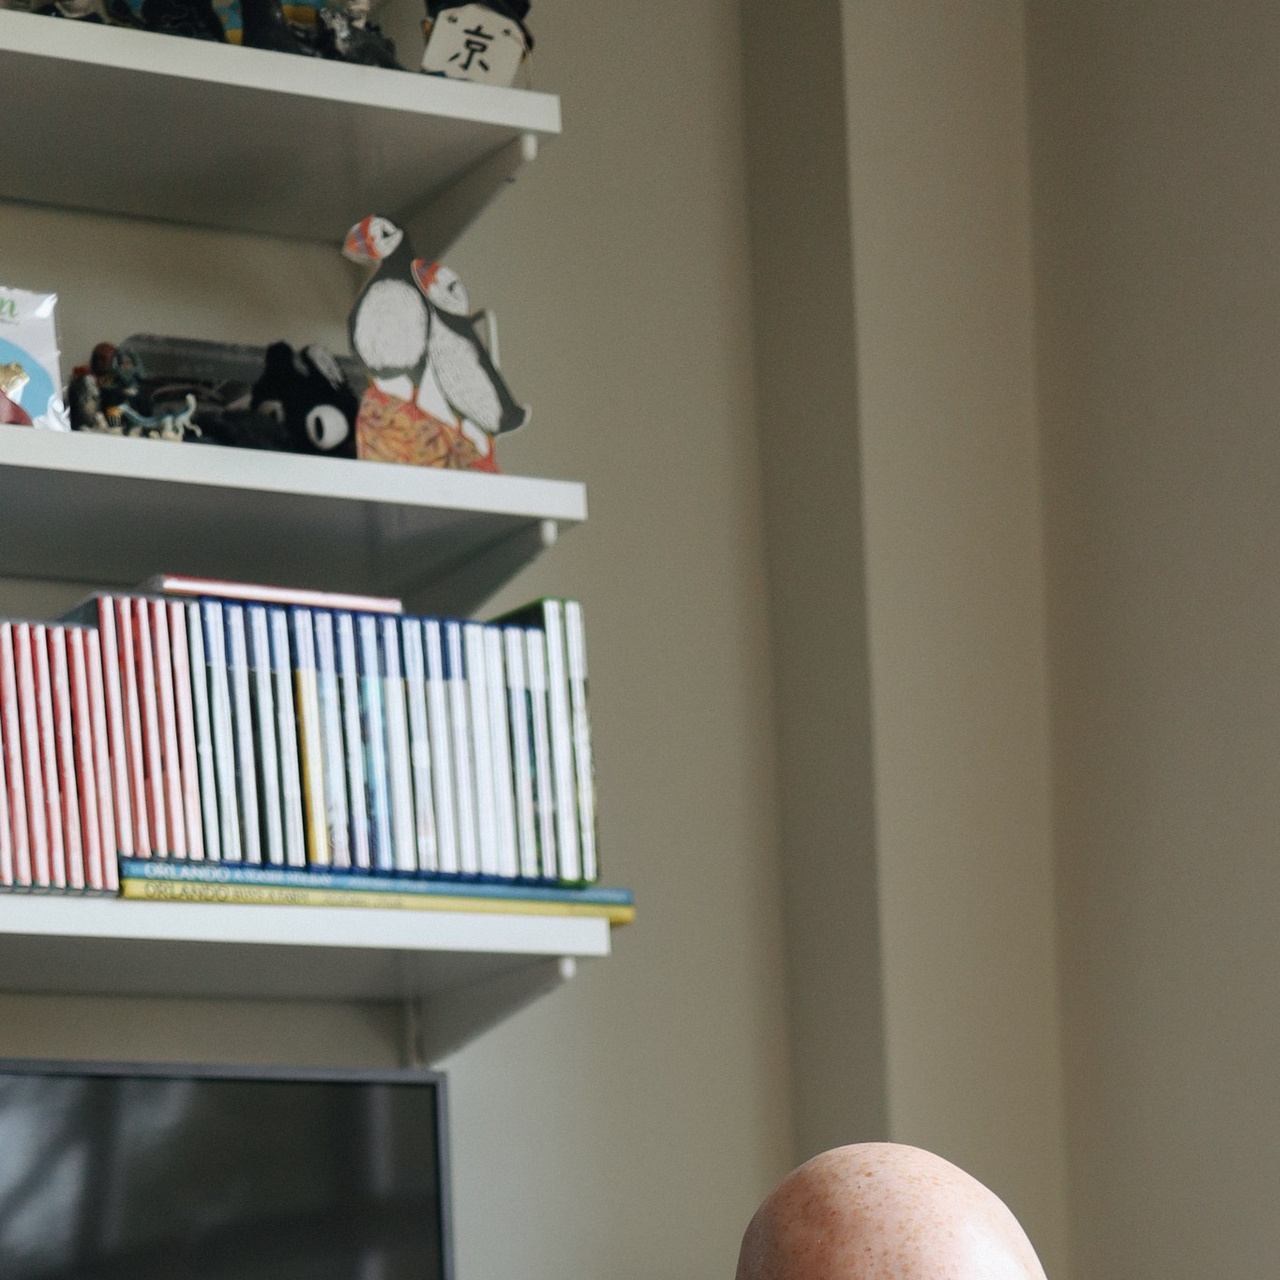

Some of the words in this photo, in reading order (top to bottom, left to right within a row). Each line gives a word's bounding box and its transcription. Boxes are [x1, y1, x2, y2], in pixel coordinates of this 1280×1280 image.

[448, 26, 494, 71] 京
[144, 862, 231, 883] ORLANDO
[145, 881, 228, 901] ORLANDO
